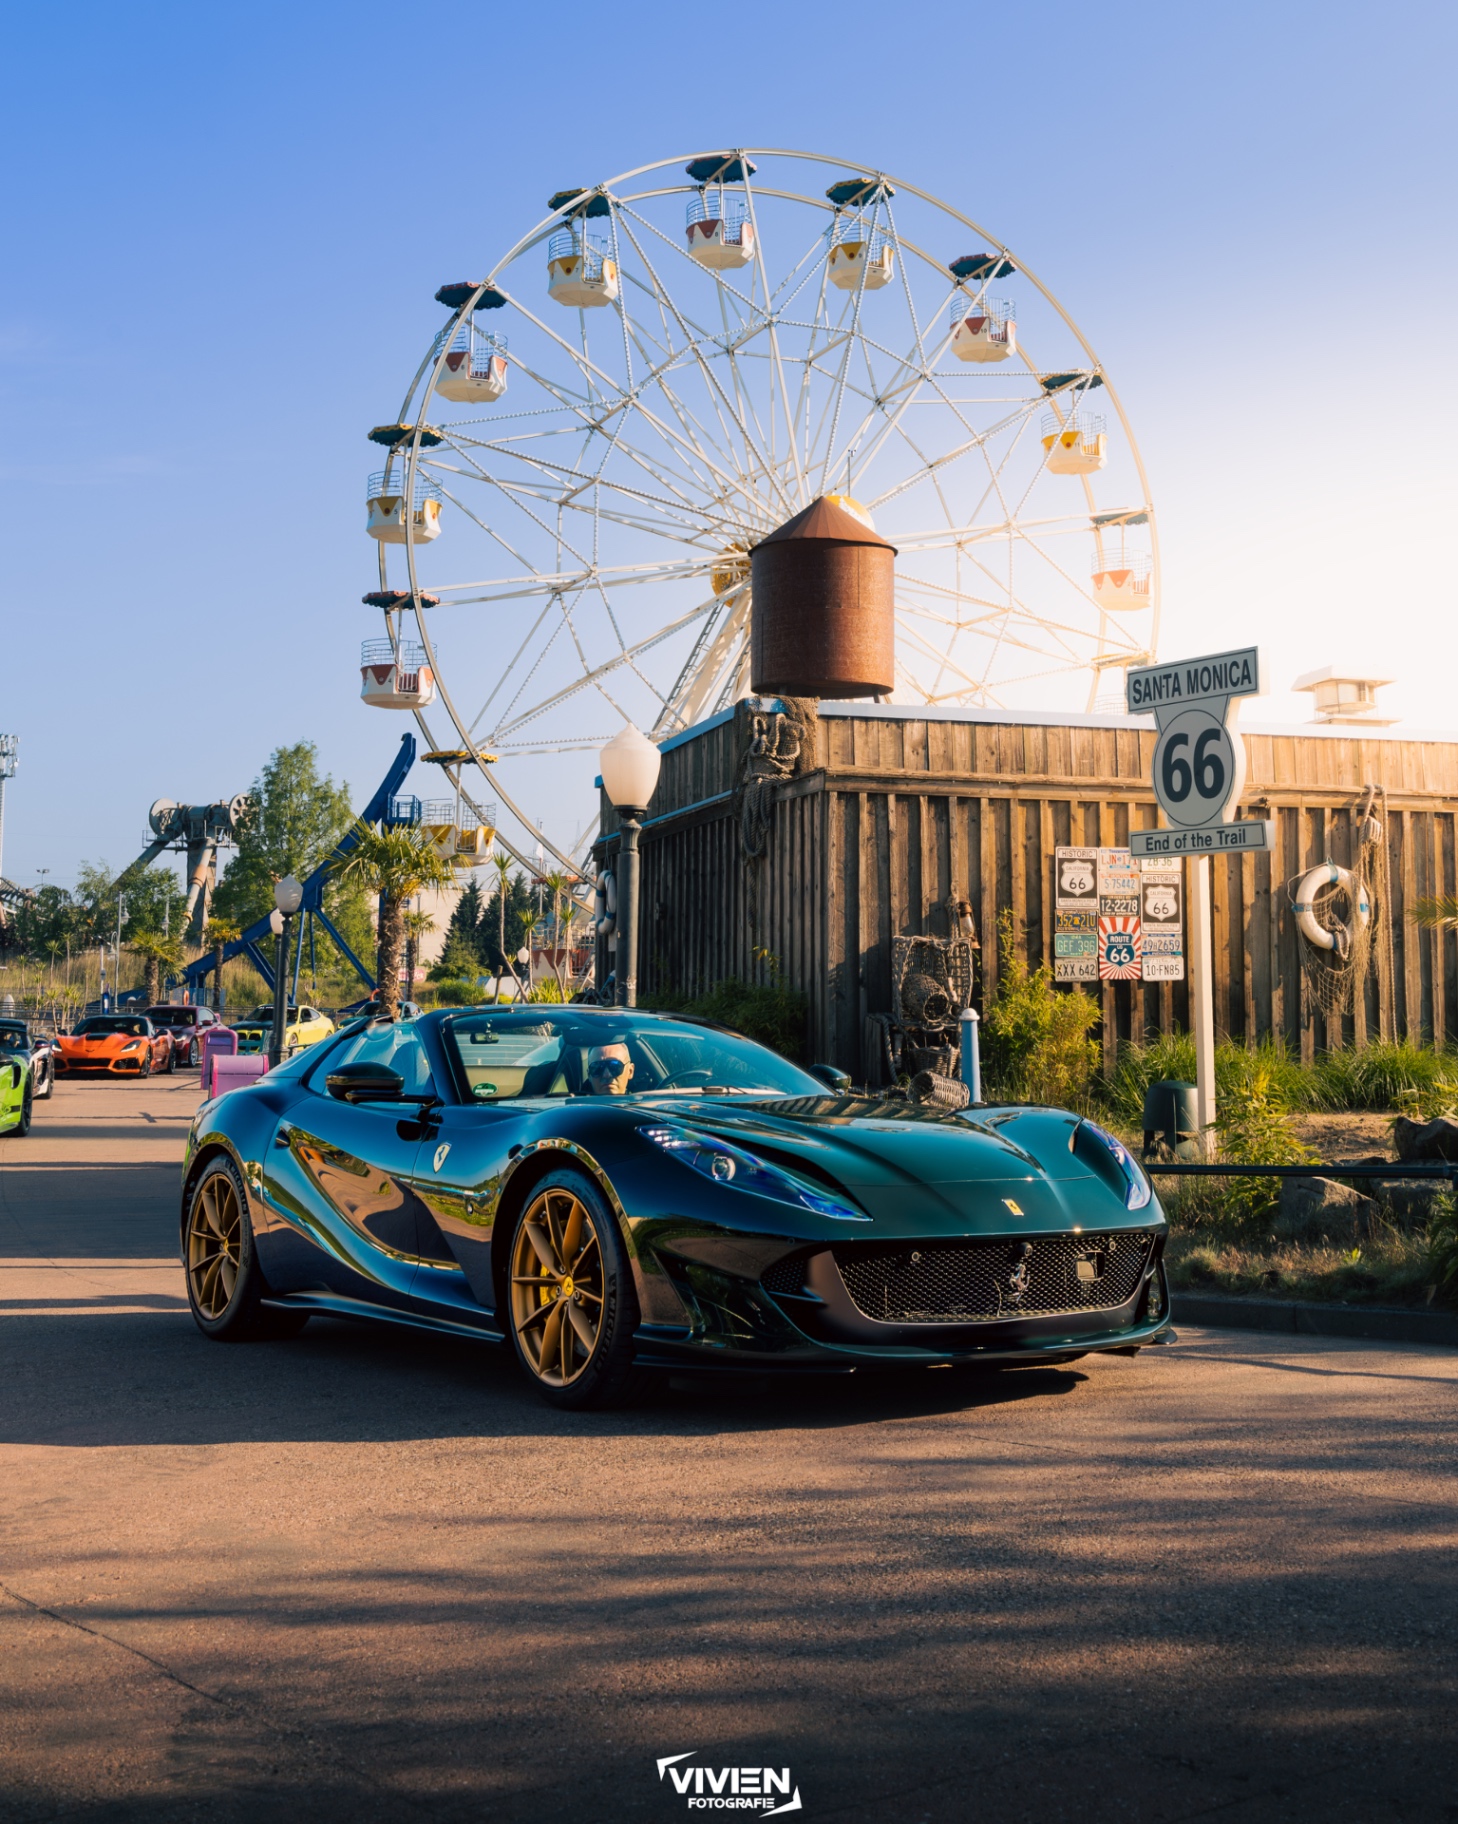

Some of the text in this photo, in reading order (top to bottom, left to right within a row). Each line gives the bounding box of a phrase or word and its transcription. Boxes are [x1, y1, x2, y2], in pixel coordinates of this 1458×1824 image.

[1133, 659, 1252, 704] SANTA MONICA
[1162, 728, 1224, 802] 66
[1146, 828, 1246, 851] End of the Trail
[1062, 850, 1092, 858] HISTORIC
[1069, 877, 1086, 890] 66
[1146, 875, 1175, 883] HISTORIC
[1153, 902, 1170, 915] 66
[1110, 935, 1130, 943] ROUTE
[1057, 940, 1095, 952] GEF 396
[1110, 948, 1130, 963] 66
[1057, 963, 1096, 976] XXX 642
